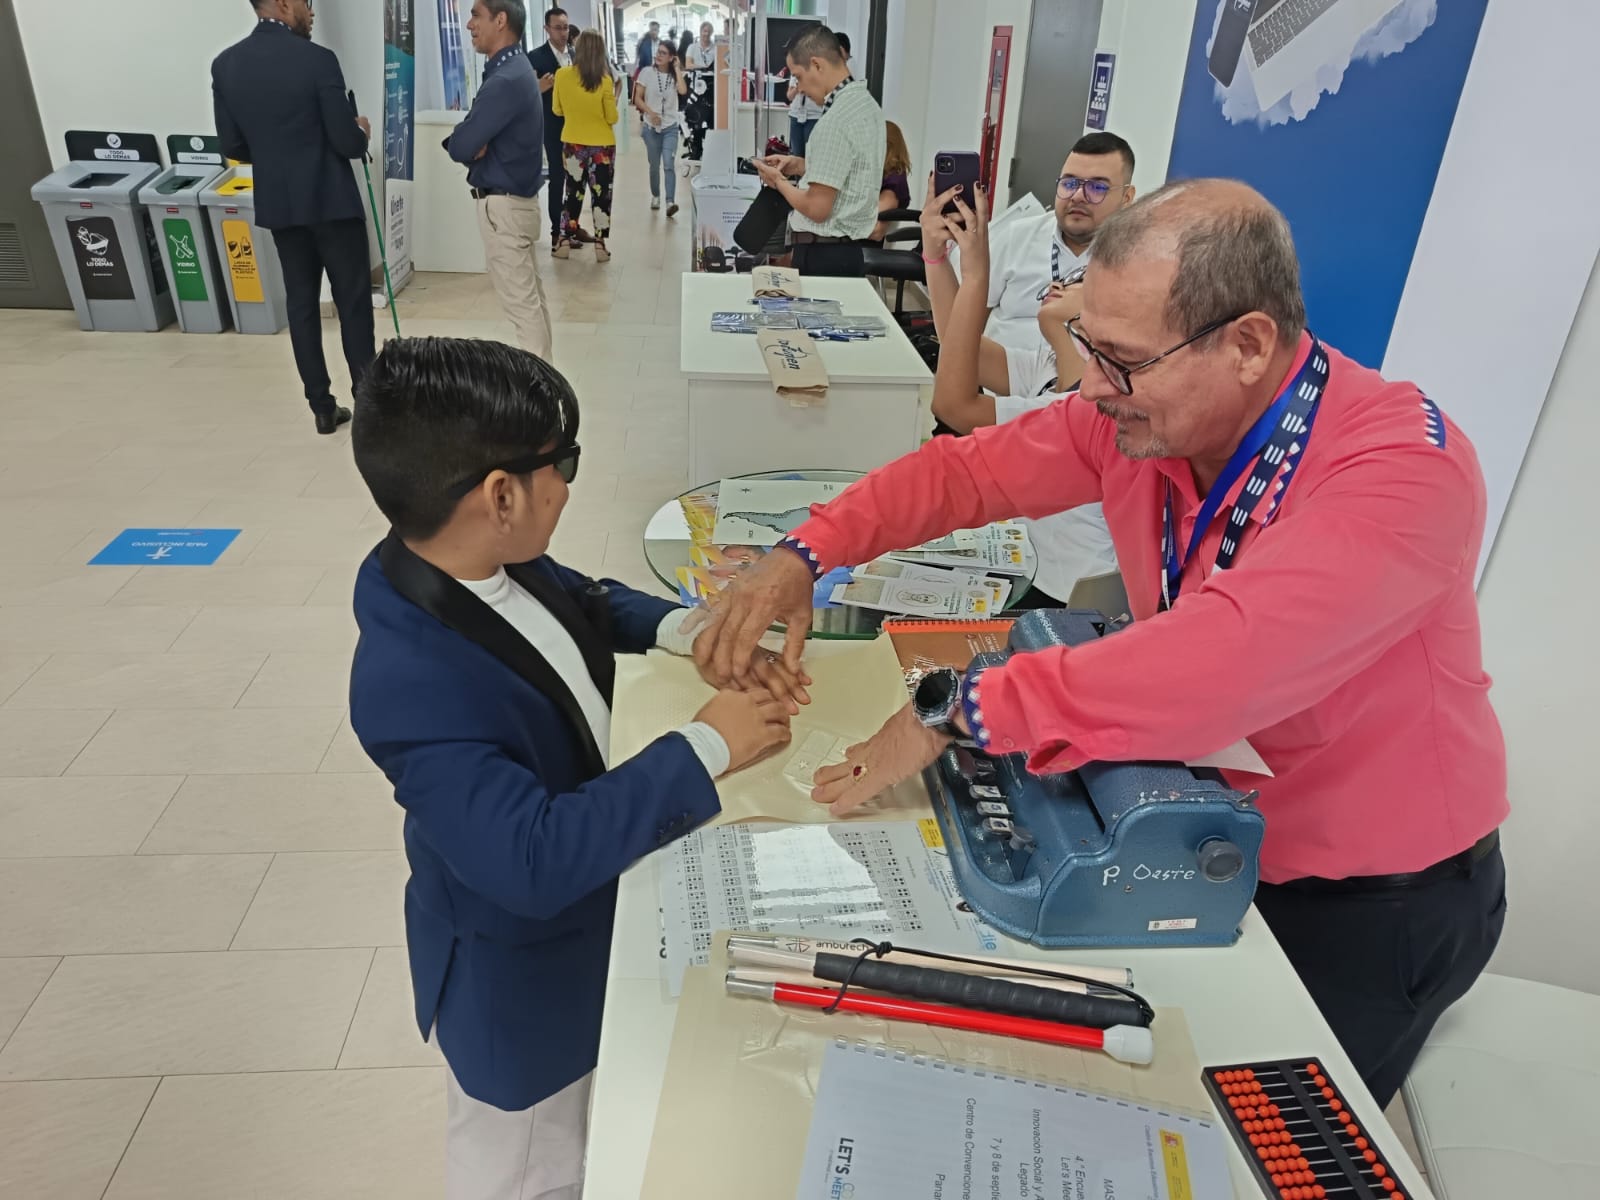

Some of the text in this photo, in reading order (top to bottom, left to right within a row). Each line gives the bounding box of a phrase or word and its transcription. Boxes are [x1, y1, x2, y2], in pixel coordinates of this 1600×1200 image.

[815, 939, 870, 951] ambutech
[966, 1097, 977, 1126] Centro
[965, 1127, 975, 1140] de
[835, 1137, 855, 1175] LET'S
[991, 1160, 1002, 1173] de
[992, 1152, 1002, 1160] 8
[1060, 1156, 1071, 1179] Let's
[1017, 1162, 1030, 1198] Legado
[1033, 1155, 1044, 1185] Social
